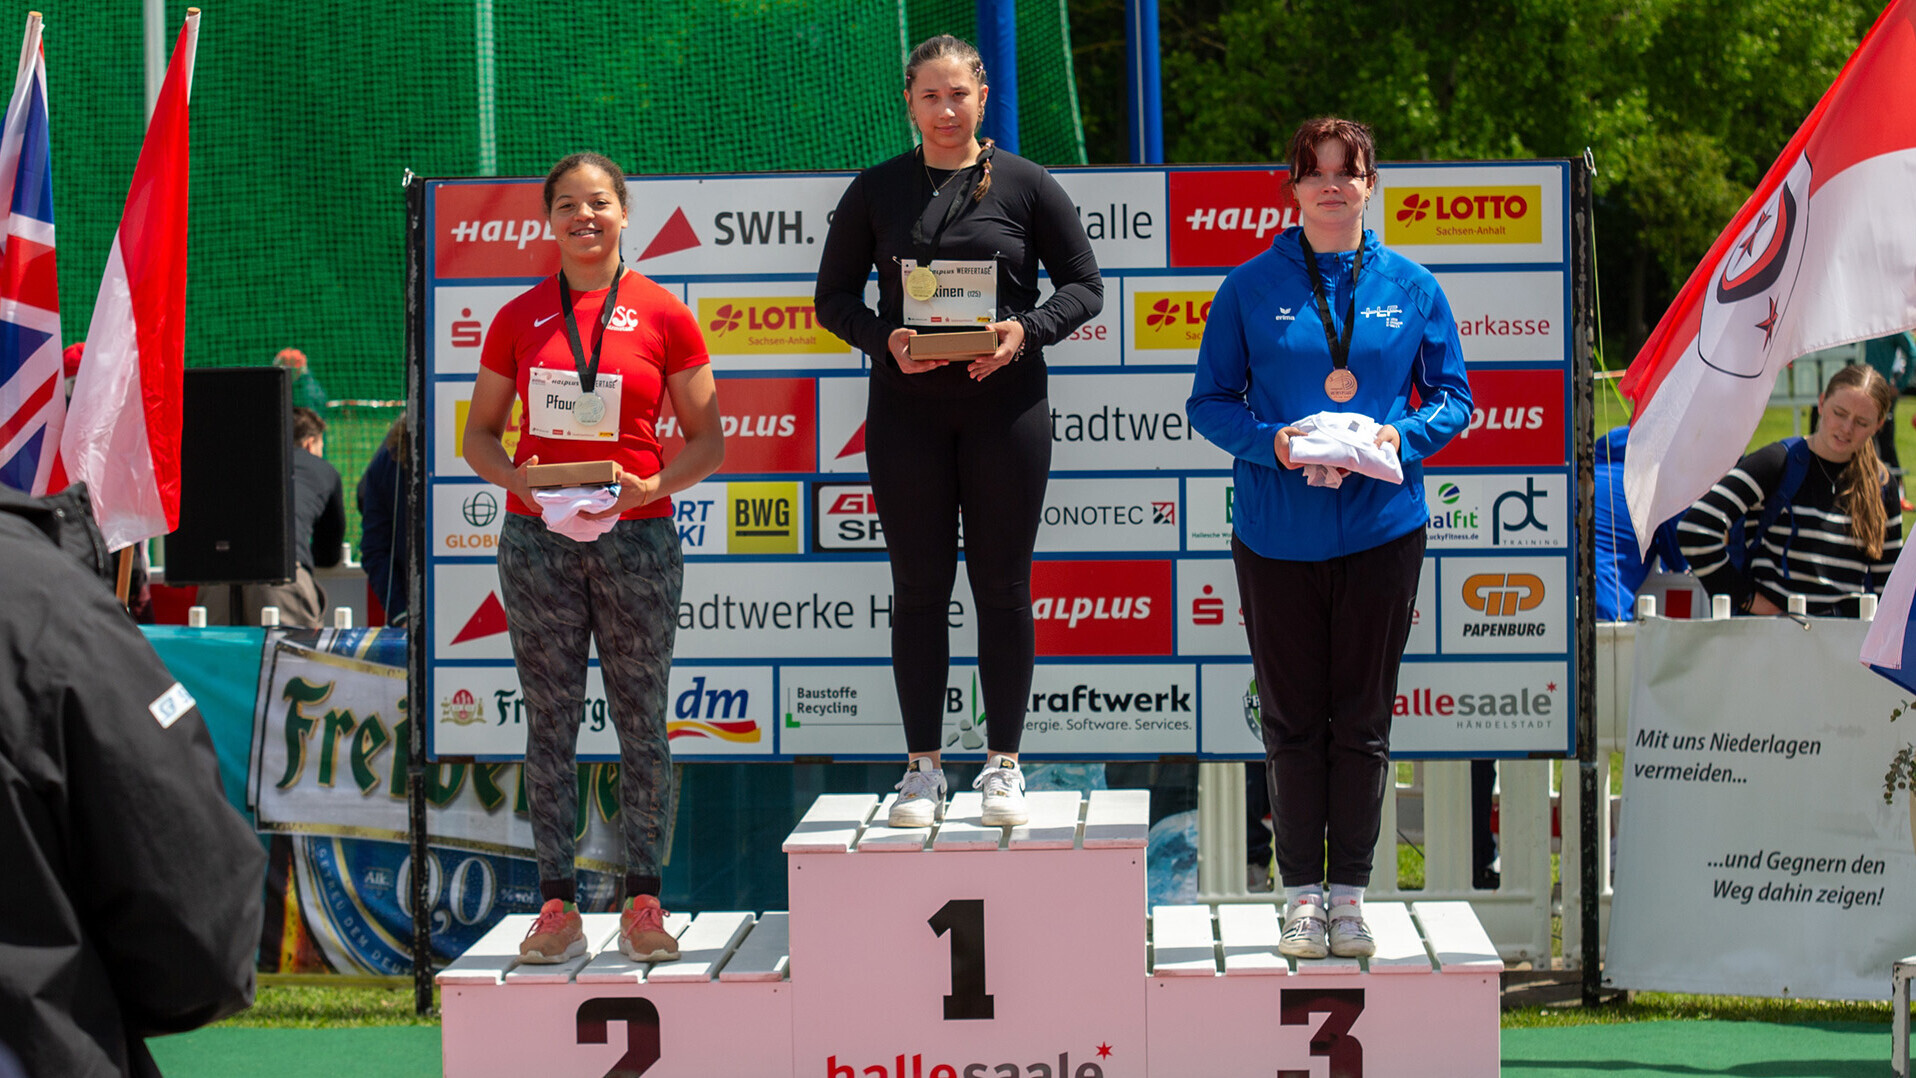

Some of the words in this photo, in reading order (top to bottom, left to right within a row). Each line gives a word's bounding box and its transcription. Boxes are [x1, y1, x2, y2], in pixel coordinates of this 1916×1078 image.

[1436, 195, 1528, 220] LOTTO
[714, 210, 815, 246] SWH.
[1075, 203, 1153, 240] alle
[1435, 226, 1507, 237] Sachsen-Anhalt
[967, 290, 982, 298] (125)
[1455, 314, 1551, 337] arkasse
[748, 335, 817, 347] Sachsen-Anhalt
[1050, 405, 1209, 442] tadtwe
[735, 498, 790, 528] BWG
[1039, 506, 1144, 526] ONOTEC
[1463, 623, 1546, 637] PAPENBURG
[675, 676, 749, 720] dm
[796, 687, 857, 699] Baustoffe
[1026, 684, 1192, 713] raftwerk
[796, 702, 858, 716] Recycling
[1066, 718, 1132, 731] Software.
[1134, 718, 1192, 731] Services.
[1456, 720, 1553, 729] HÄNDELSTADT
[1635, 728, 1670, 750] Mit
[1672, 735, 1706, 751] uns
[1709, 732, 1822, 760] Niederlagen
[1634, 763, 1748, 784] vermeiden...
[1707, 850, 1763, 870] ...und
[1766, 851, 1847, 876] Gegnern
[1851, 854, 1886, 875] den
[364, 871, 391, 885] Alk.
[1713, 880, 1754, 905] Weg
[1758, 881, 1813, 903] dahin
[1815, 885, 1885, 910] zeigen!
[927, 898, 995, 1021] 1
[575, 996, 661, 1078] 2
[1277, 987, 1366, 1078] 3
